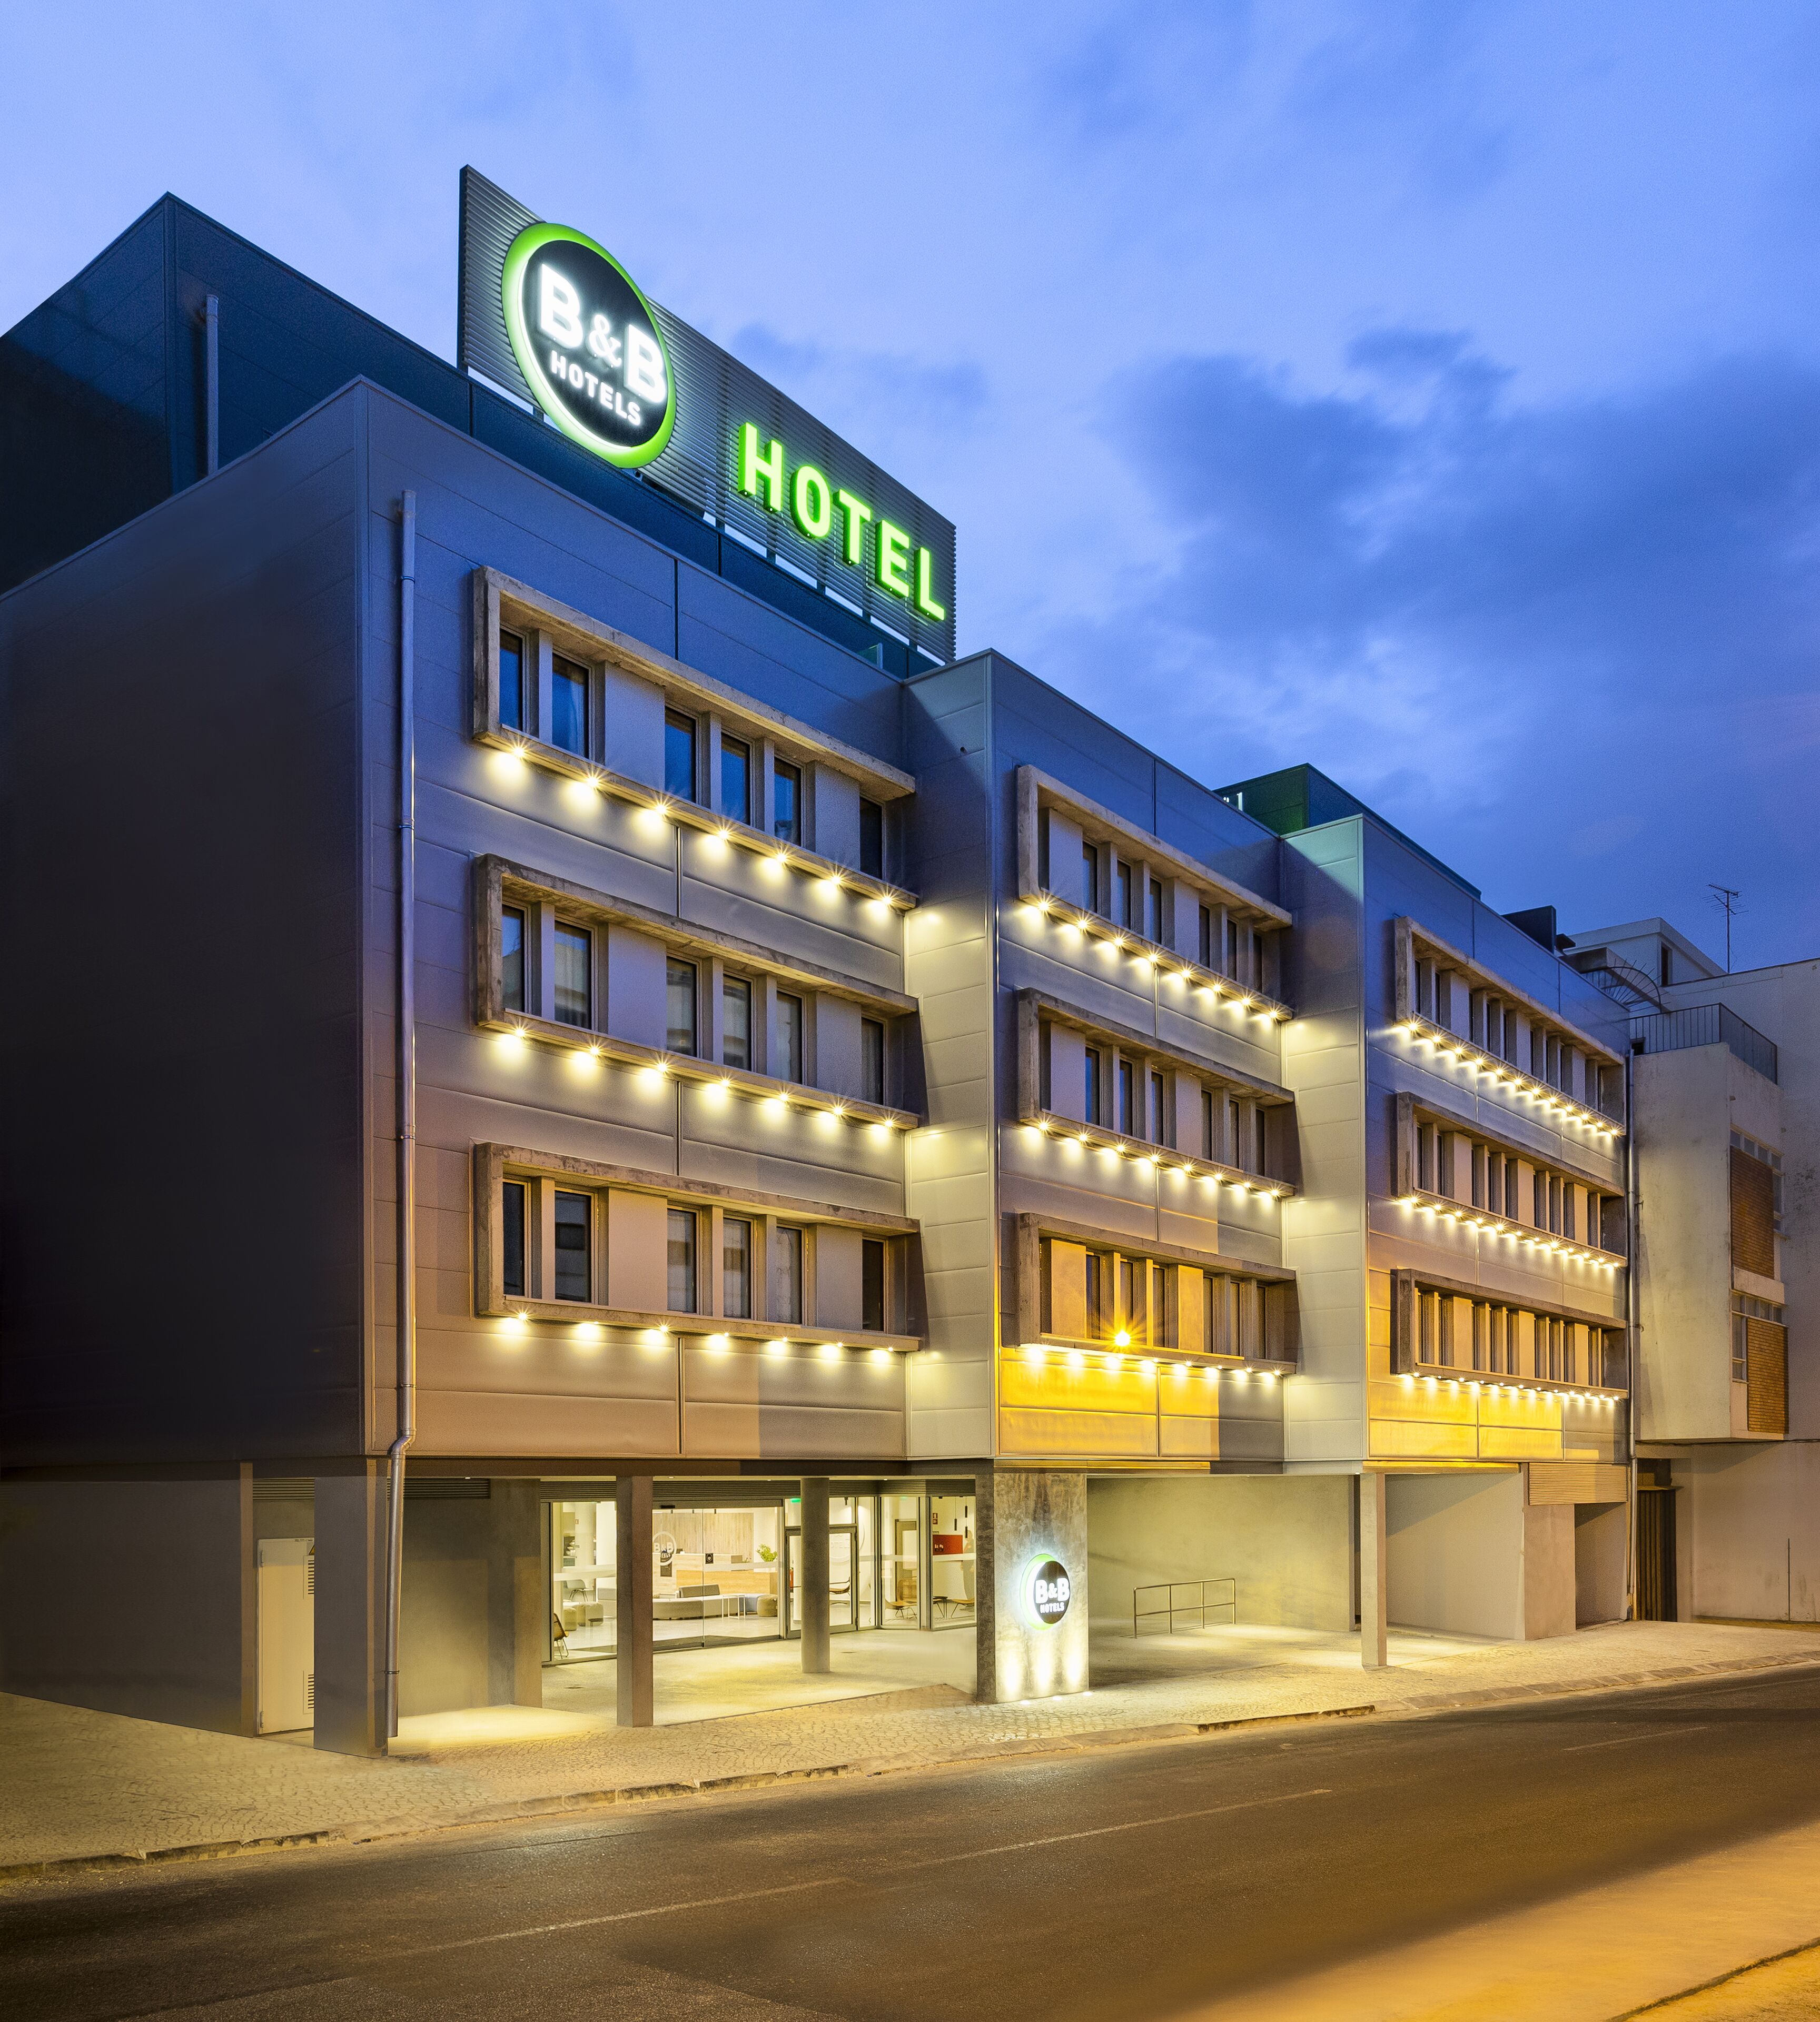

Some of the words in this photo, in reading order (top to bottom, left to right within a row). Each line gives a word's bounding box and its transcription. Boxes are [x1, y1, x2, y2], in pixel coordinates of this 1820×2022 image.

[538, 263, 667, 403] B&B
[551, 349, 641, 425] HOTELS
[738, 422, 945, 621] HOTEL
[1035, 1578, 1070, 1603] B&B
[1040, 1602, 1065, 1613] HOTELS
